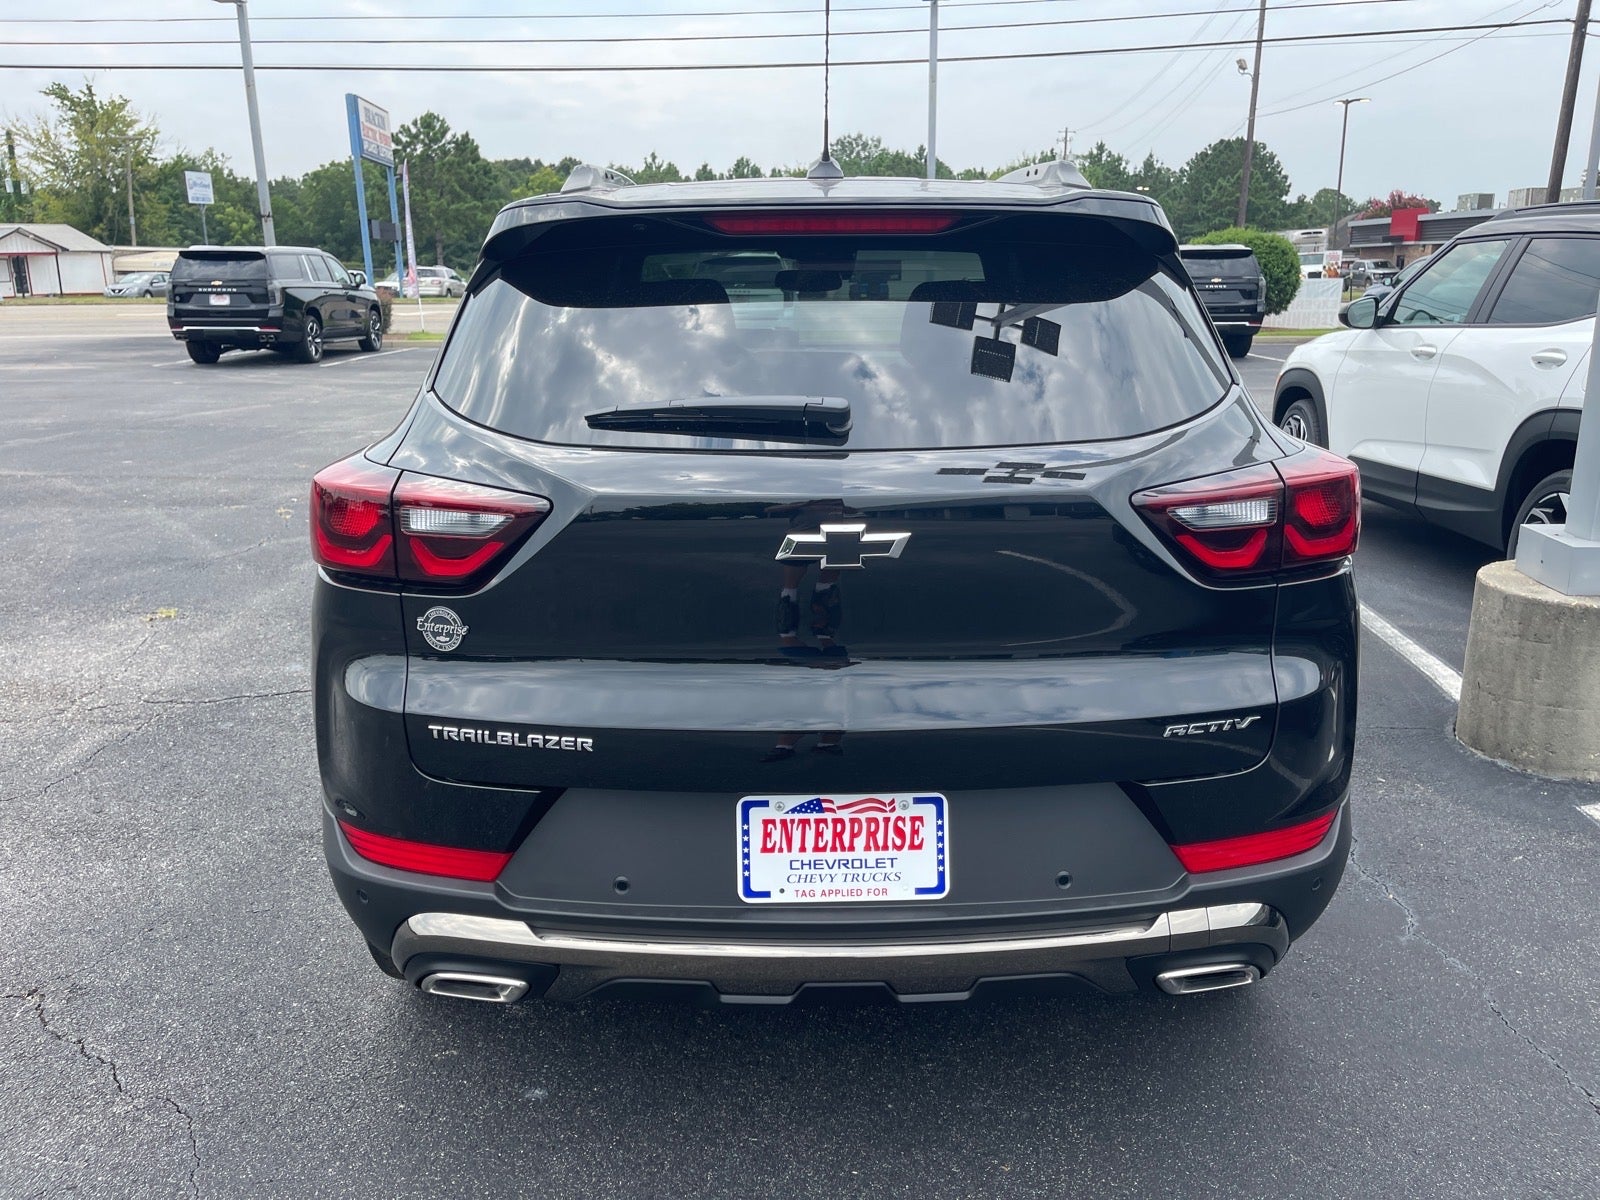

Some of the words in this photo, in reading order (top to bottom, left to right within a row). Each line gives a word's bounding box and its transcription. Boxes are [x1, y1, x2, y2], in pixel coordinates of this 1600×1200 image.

[416, 616, 469, 636] Enterprise
[1163, 716, 1261, 738] ACTIV
[428, 725, 593, 752] TRAILBLAZER
[760, 816, 924, 853] ENTERPRISE
[790, 858, 898, 870] CHEVROLET
[786, 873, 837, 884] CHEVY
[841, 872, 902, 882] TRUCKS
[795, 890, 816, 898] TAG
[820, 888, 863, 897] APPLIED
[867, 888, 888, 896] FOR
